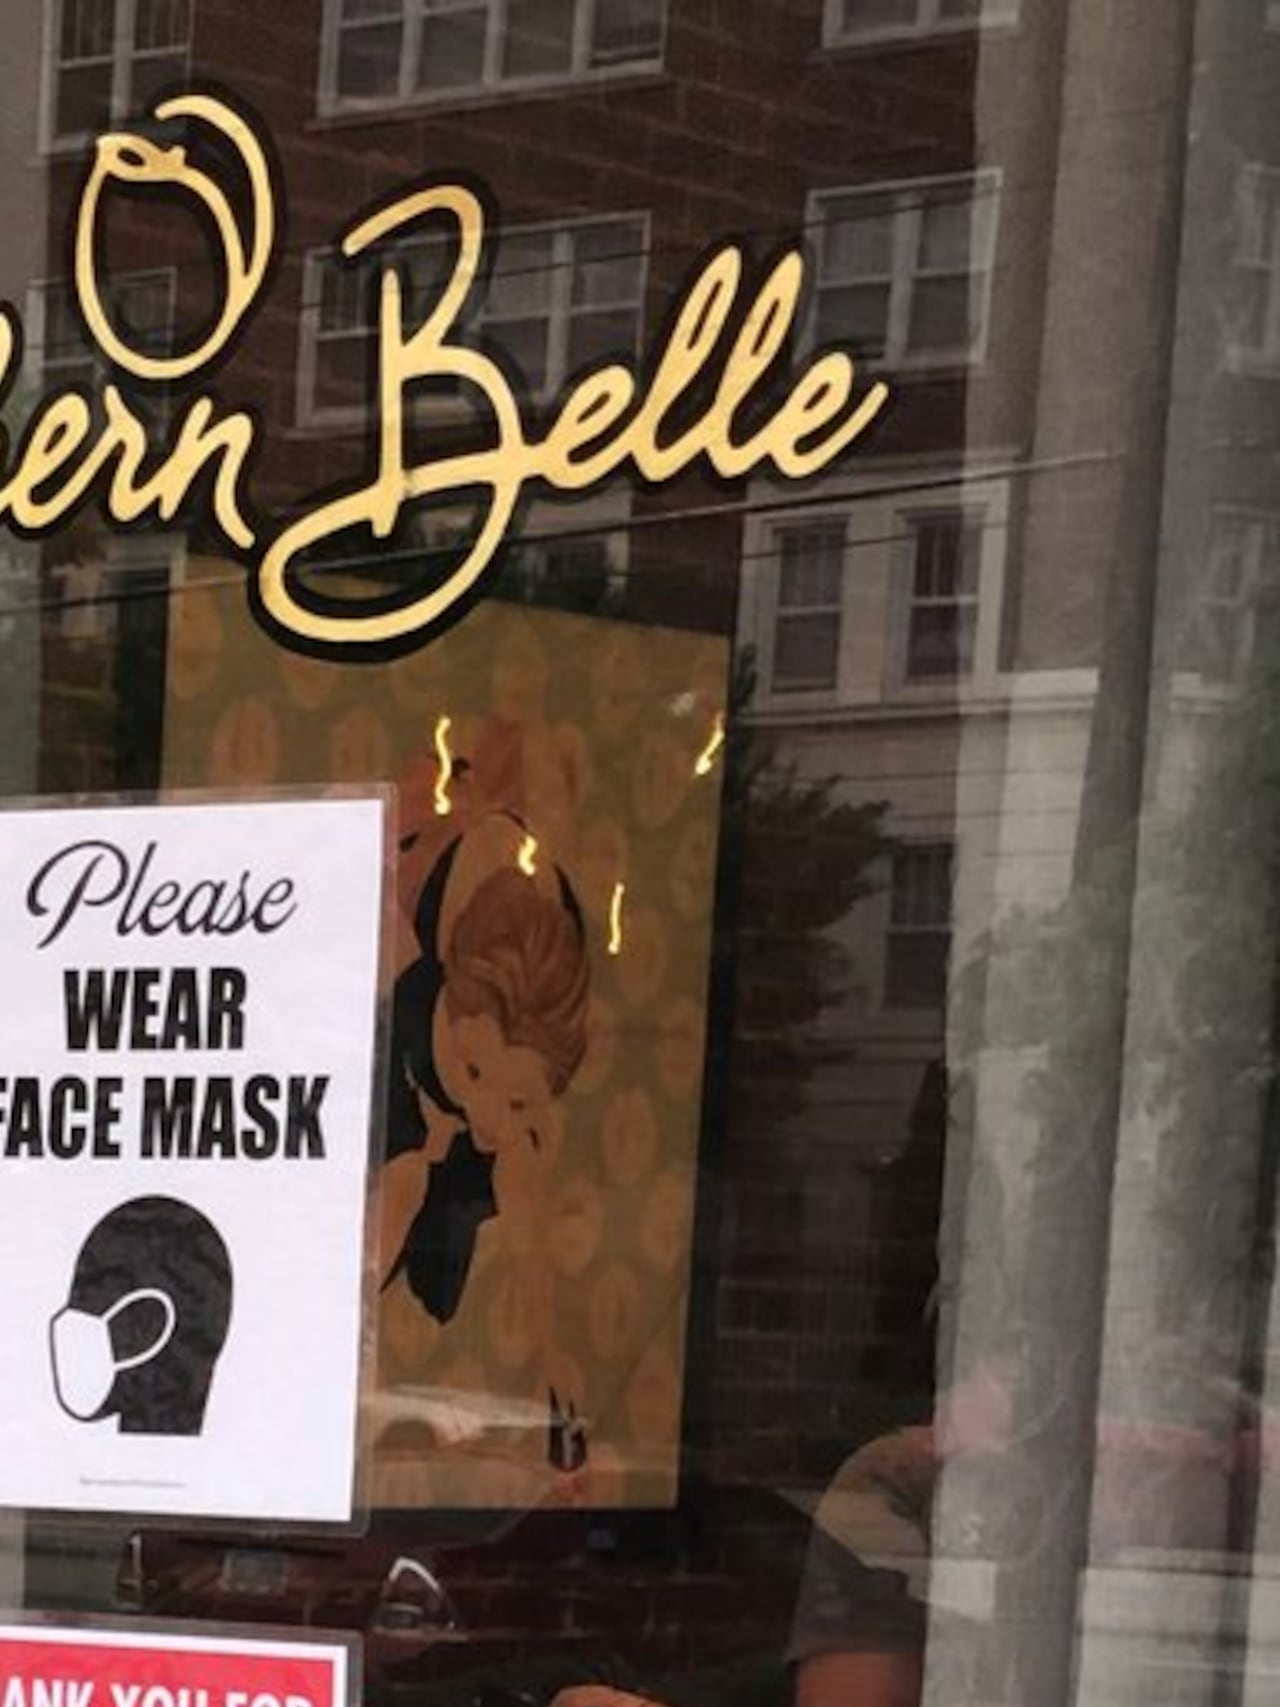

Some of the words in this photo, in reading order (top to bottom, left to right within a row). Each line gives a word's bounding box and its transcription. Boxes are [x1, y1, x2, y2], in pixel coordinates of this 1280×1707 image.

[256, 182, 888, 644] Belle
[26, 839, 297, 949] Please
[62, 965, 248, 1053] WEAR
[139, 1073, 331, 1161] MASK
